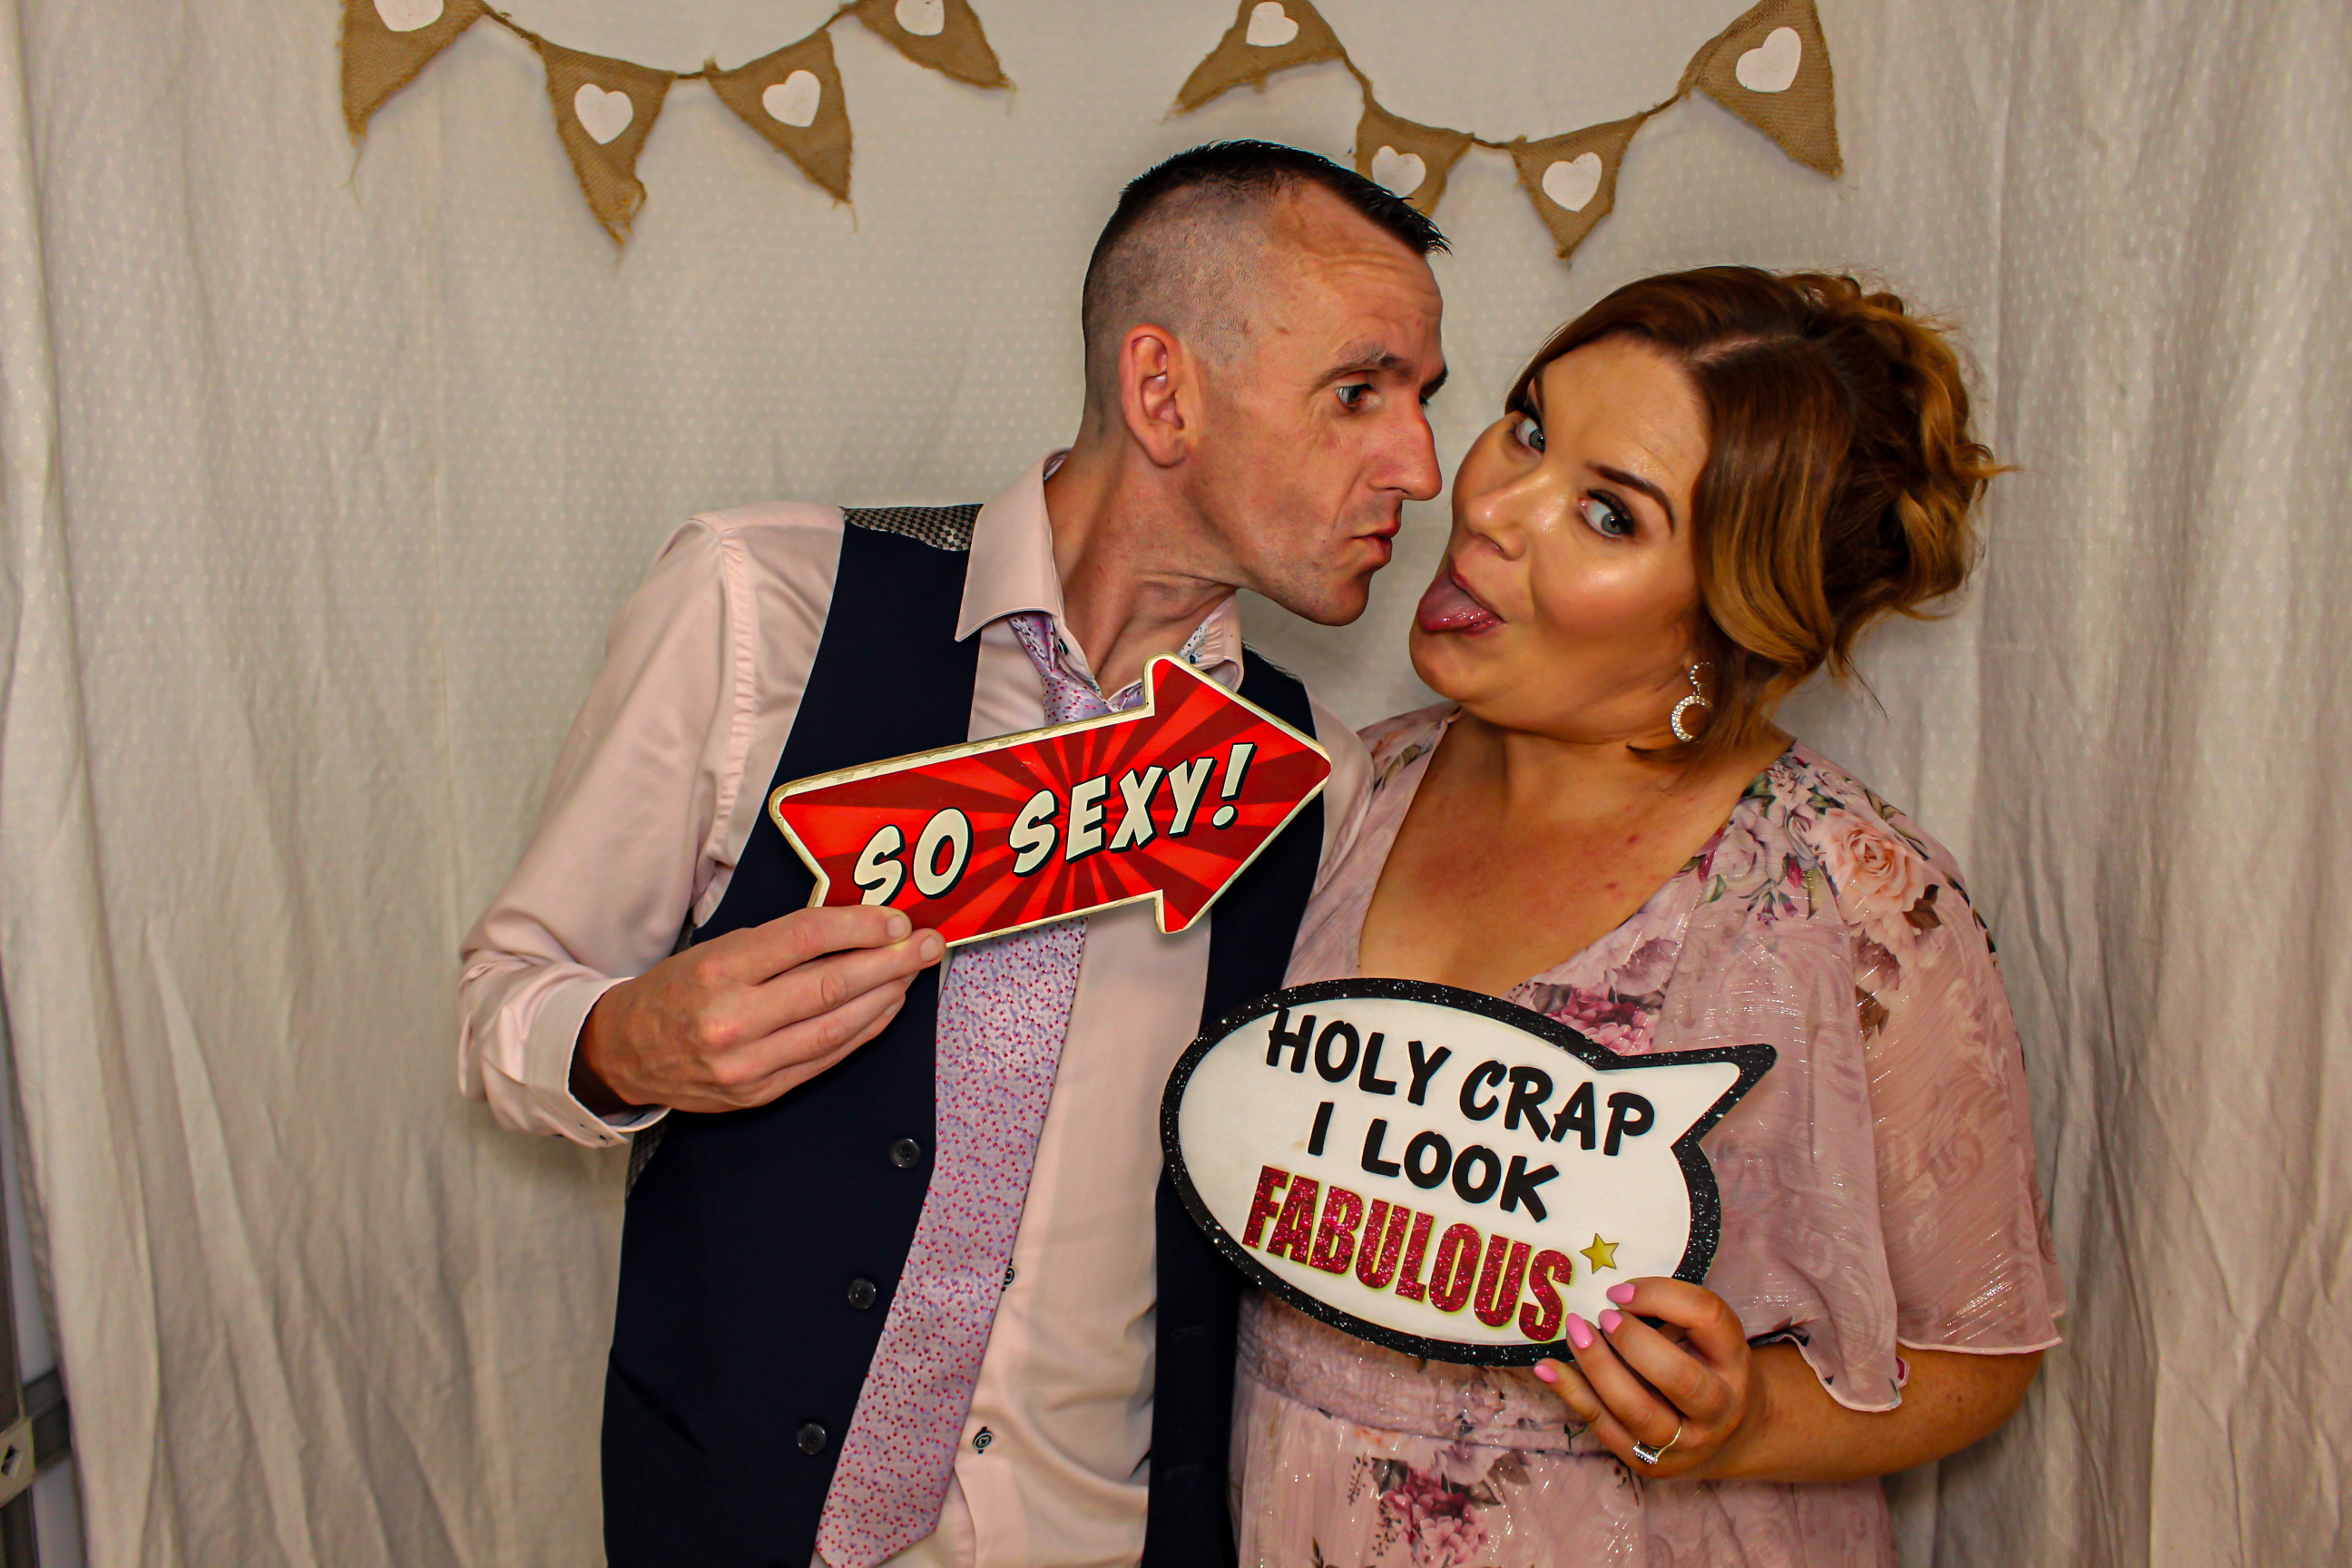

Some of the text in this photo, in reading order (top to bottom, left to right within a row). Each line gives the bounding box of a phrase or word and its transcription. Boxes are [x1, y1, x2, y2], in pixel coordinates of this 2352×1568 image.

[853, 742, 1255, 906] SO SEXY!
[1266, 1007, 1655, 1157] HOLY CRAP
[1307, 1101, 1560, 1223] I LOOK
[1241, 1165, 1573, 1343] FABULOUS
